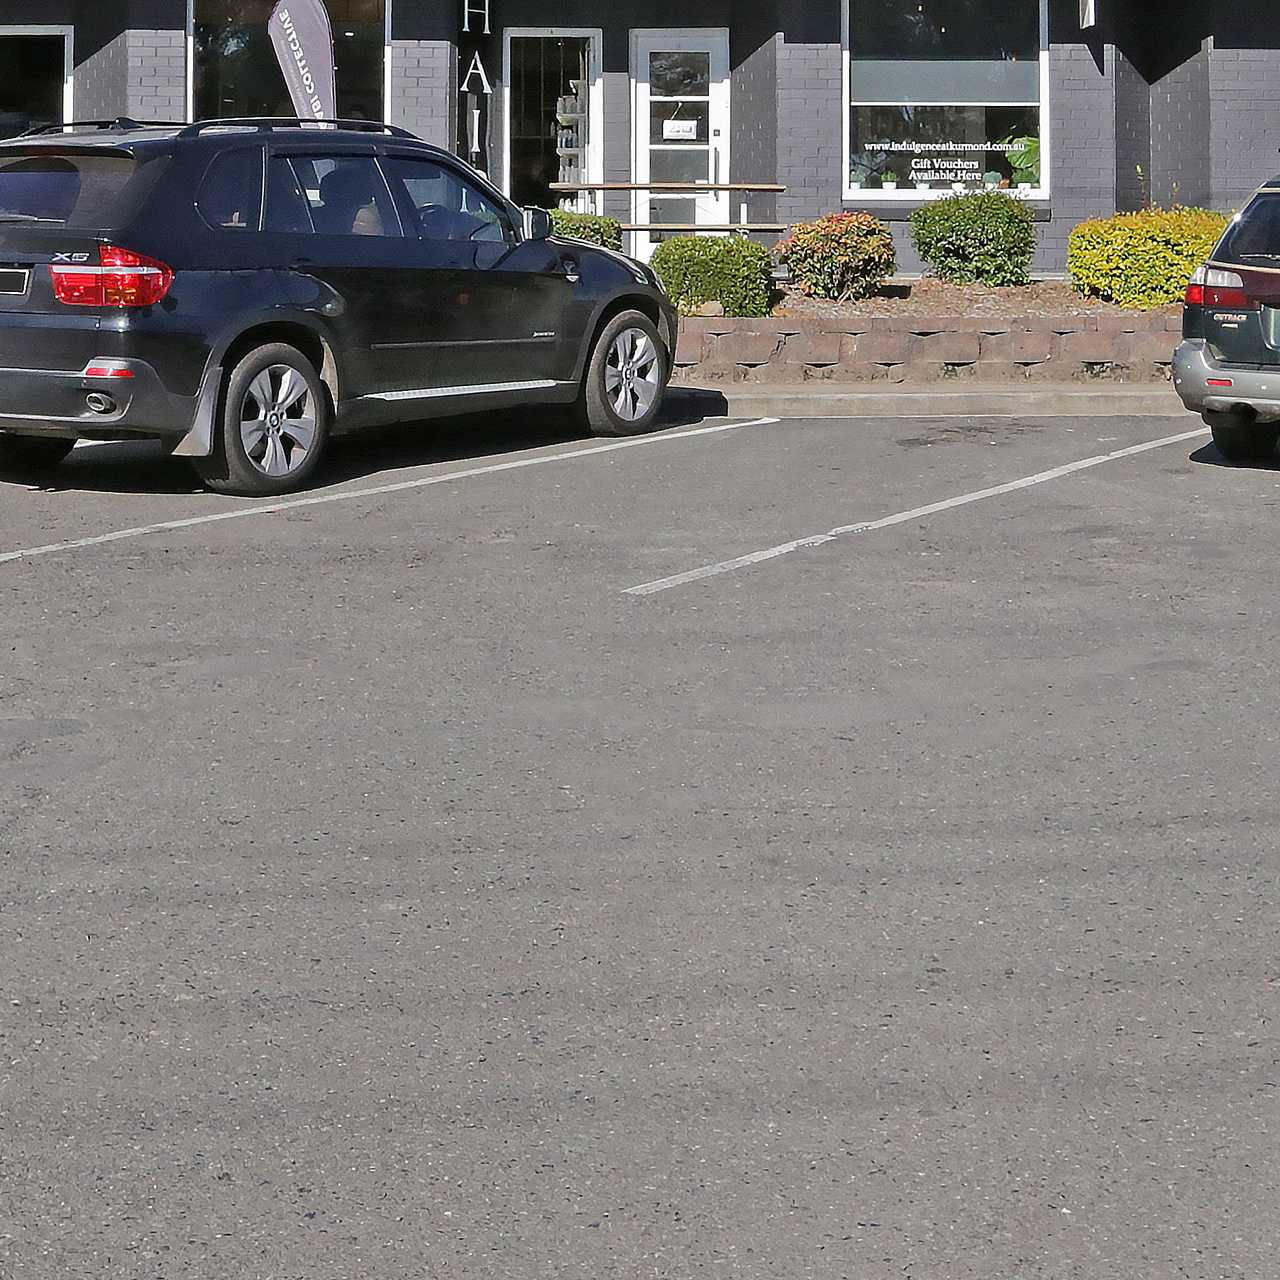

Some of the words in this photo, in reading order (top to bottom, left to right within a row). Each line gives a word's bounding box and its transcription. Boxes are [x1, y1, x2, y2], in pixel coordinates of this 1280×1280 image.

[911, 158, 932, 169] Gift
[933, 158, 979, 169] Vouchers
[908, 170, 956, 181] Available
[957, 170, 983, 181] Here
[51, 252, 91, 262] X5
